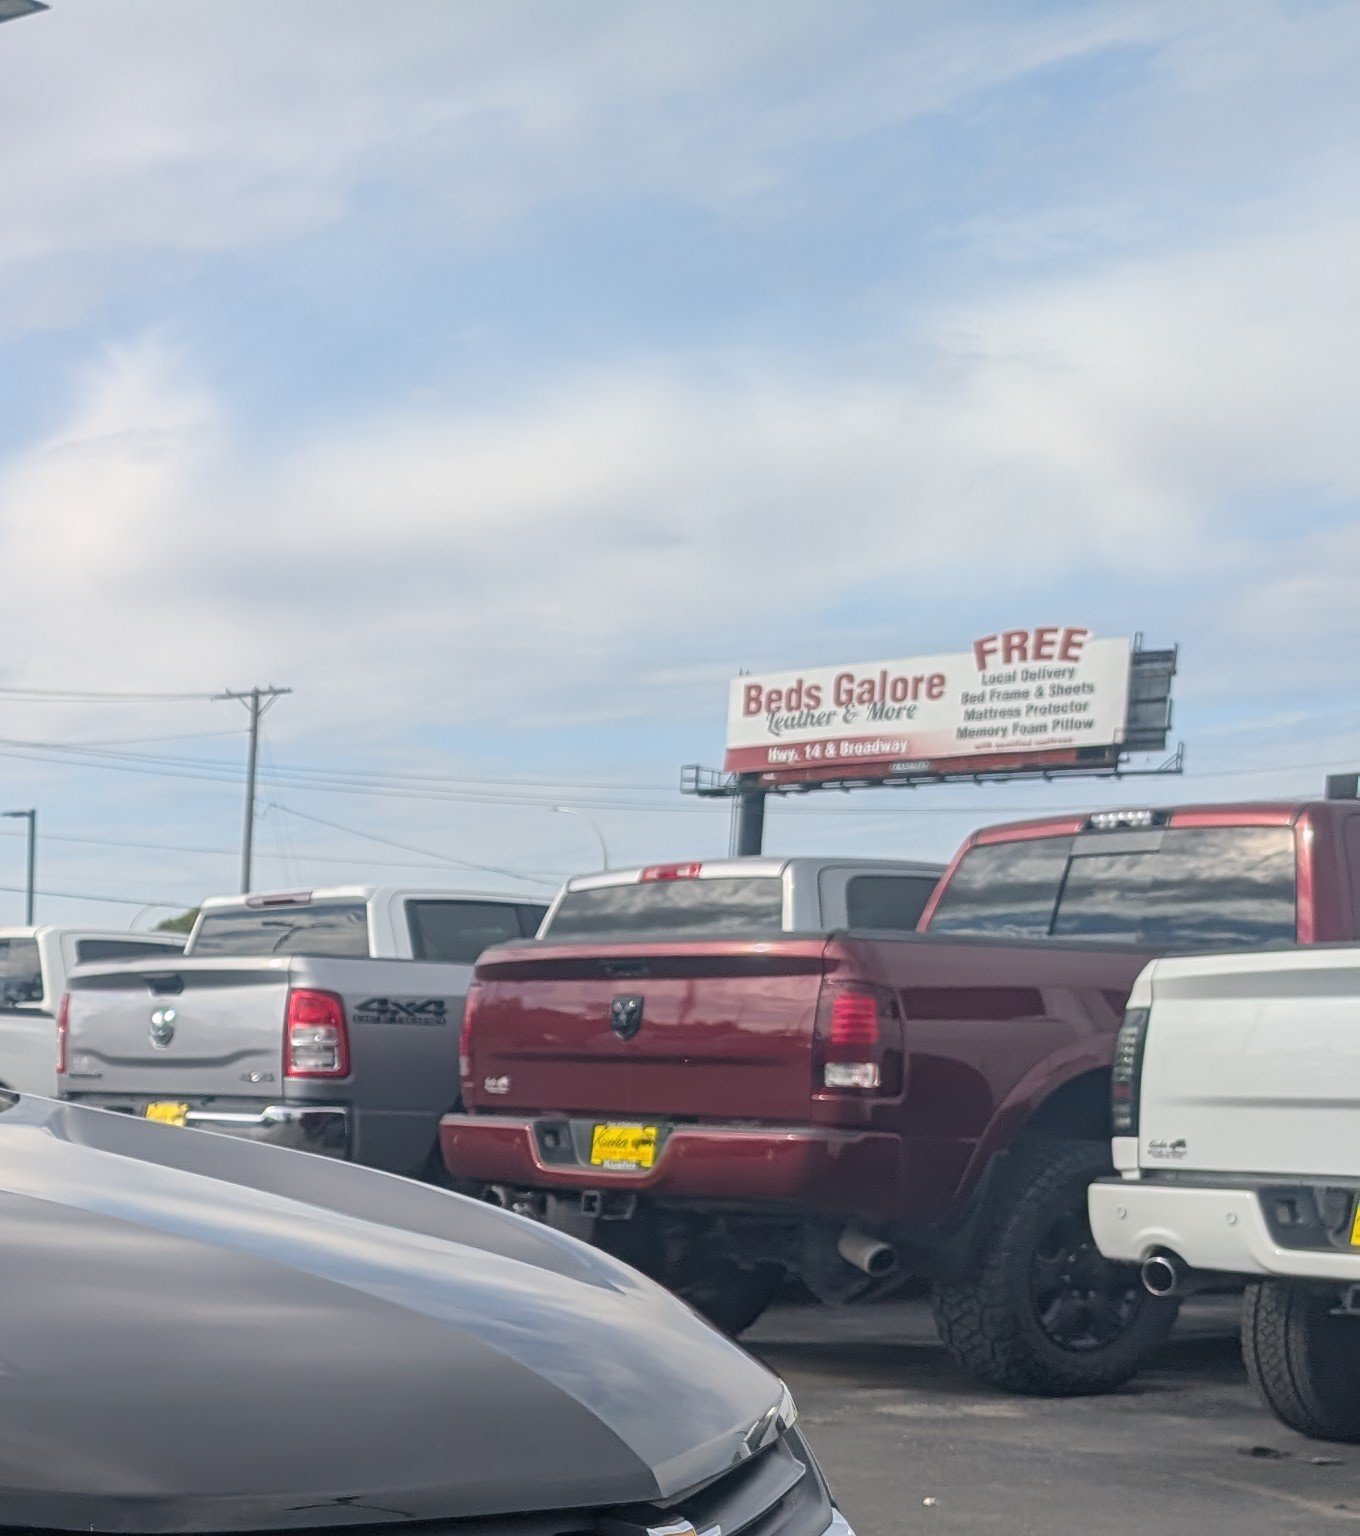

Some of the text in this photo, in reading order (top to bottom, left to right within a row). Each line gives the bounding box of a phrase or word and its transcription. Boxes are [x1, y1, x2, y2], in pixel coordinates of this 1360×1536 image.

[973, 626, 1088, 670] FREE
[982, 667, 1074, 685] Local Delivery
[744, 670, 946, 716] Beds Galore
[961, 682, 1094, 705] Bed Frame & Sheets
[766, 701, 917, 736] Leather & More
[964, 701, 1089, 720] Mattress Protector
[957, 719, 1095, 739] Memory Foam Pillow
[805, 744, 820, 758] 14
[825, 742, 836, 756] &
[840, 739, 907, 756] Broadway
